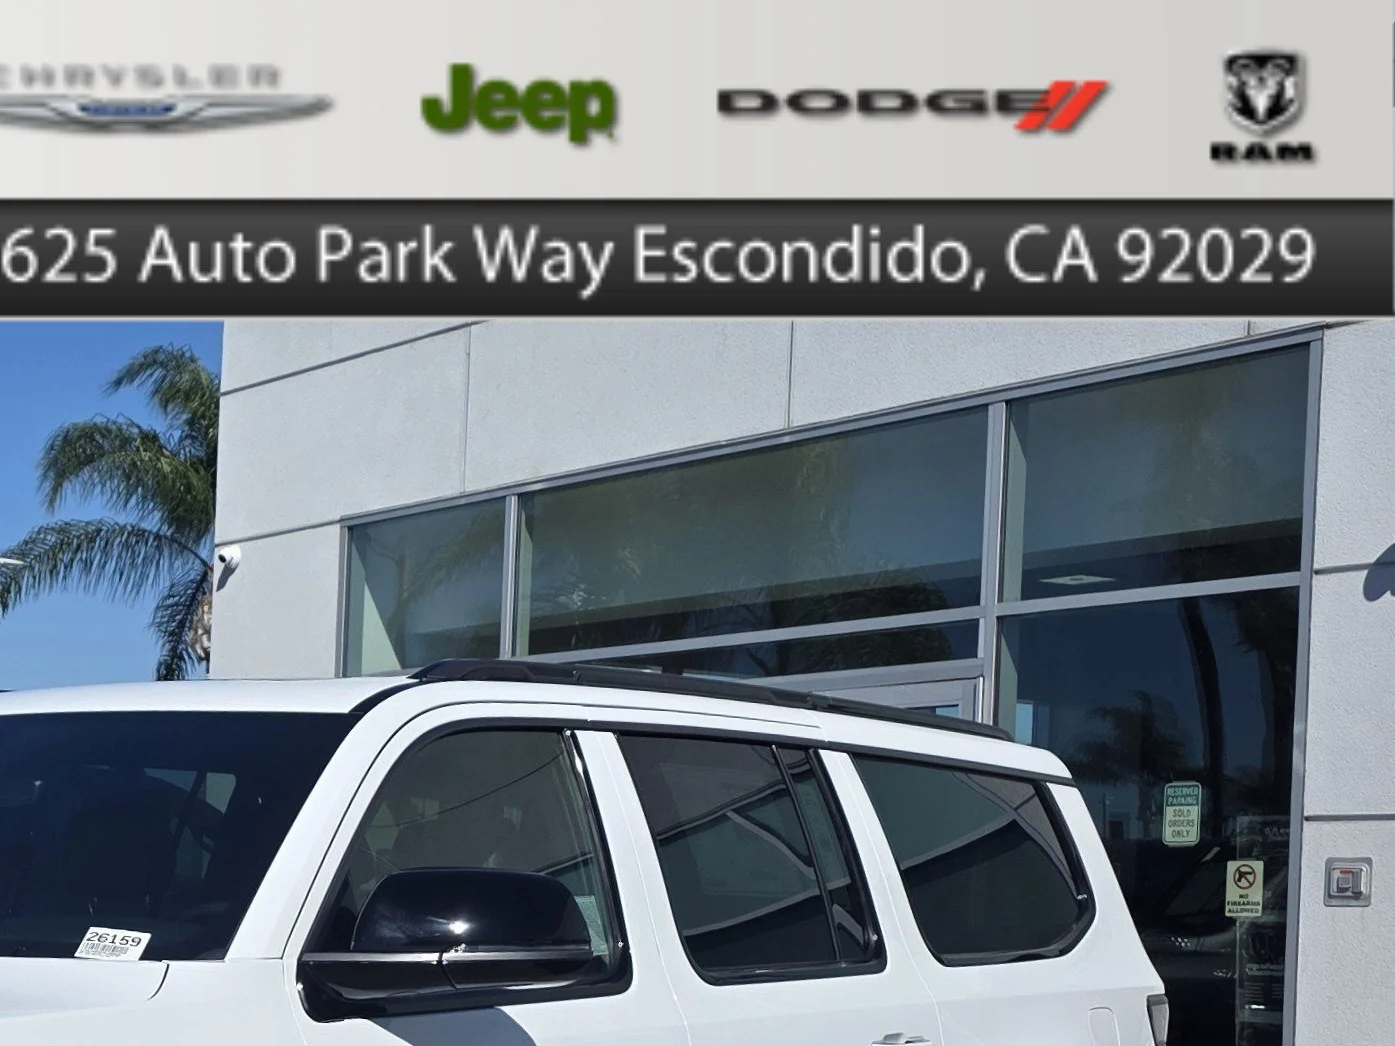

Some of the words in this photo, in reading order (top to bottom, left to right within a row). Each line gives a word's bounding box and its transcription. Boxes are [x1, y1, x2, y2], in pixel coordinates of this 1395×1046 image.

[1166, 787, 1199, 796] RESERVED
[1167, 796, 1197, 806] PARKING
[1172, 808, 1192, 818] SOLD
[1167, 819, 1195, 828] ORDERS
[1171, 829, 1191, 838] ONLY
[86, 931, 142, 947] 26159
